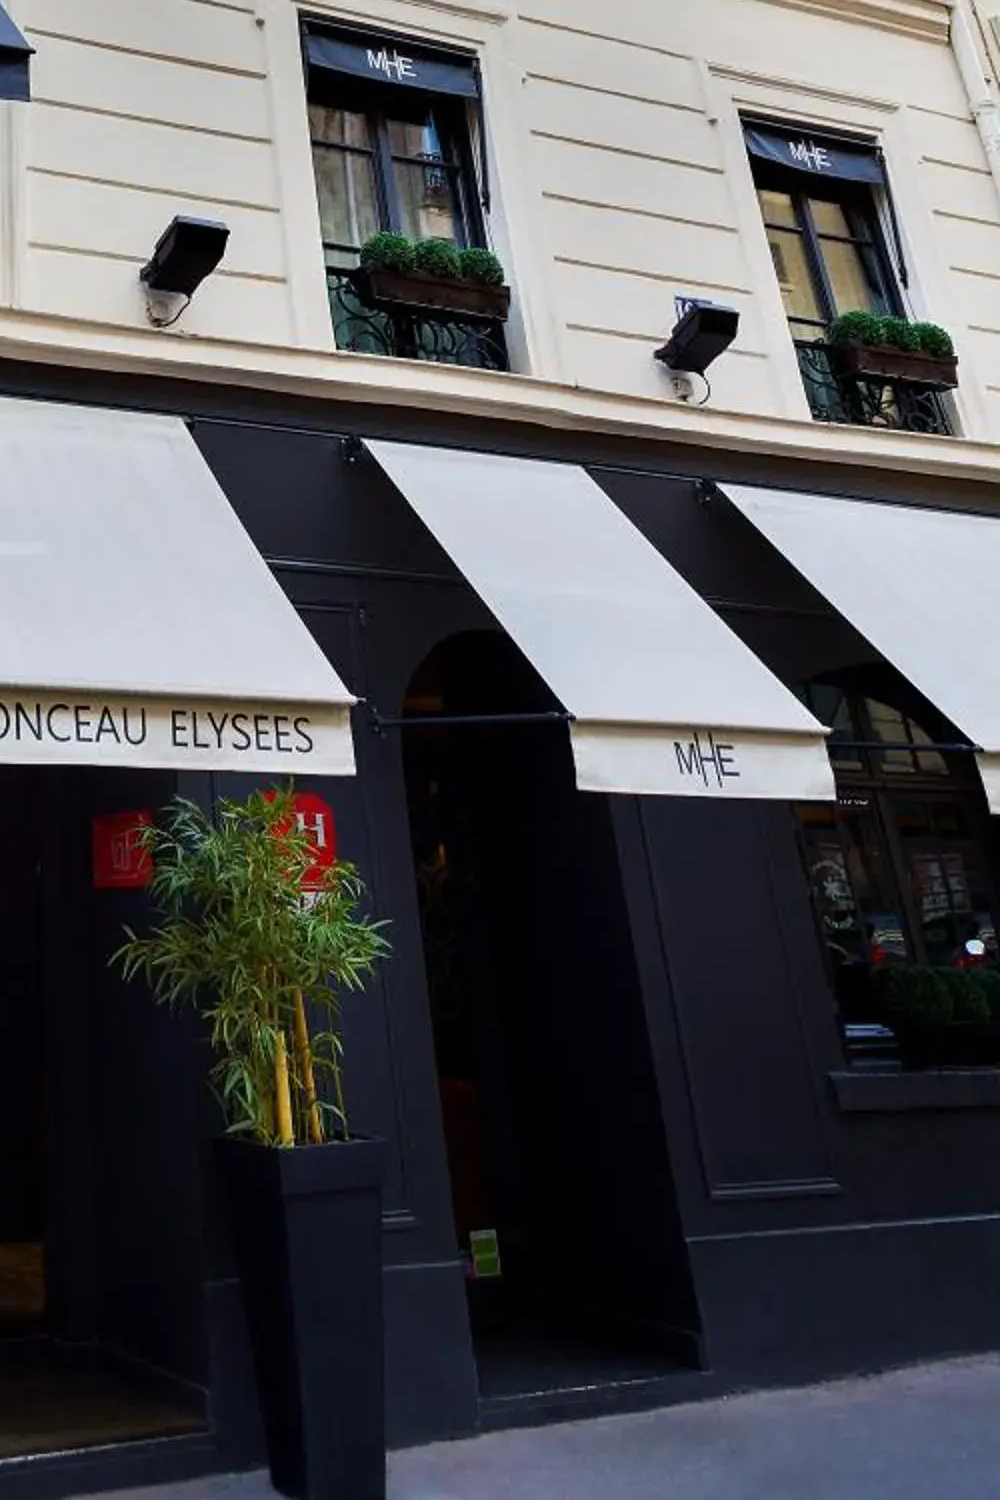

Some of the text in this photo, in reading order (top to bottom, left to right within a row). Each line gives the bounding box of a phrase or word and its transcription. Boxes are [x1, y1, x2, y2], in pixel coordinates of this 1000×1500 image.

[365, 47, 417, 81] MHE
[787, 139, 832, 171] MHE
[171, 709, 314, 754] ELYSEES
[672, 730, 741, 789] MHE
[292, 811, 327, 848] H
